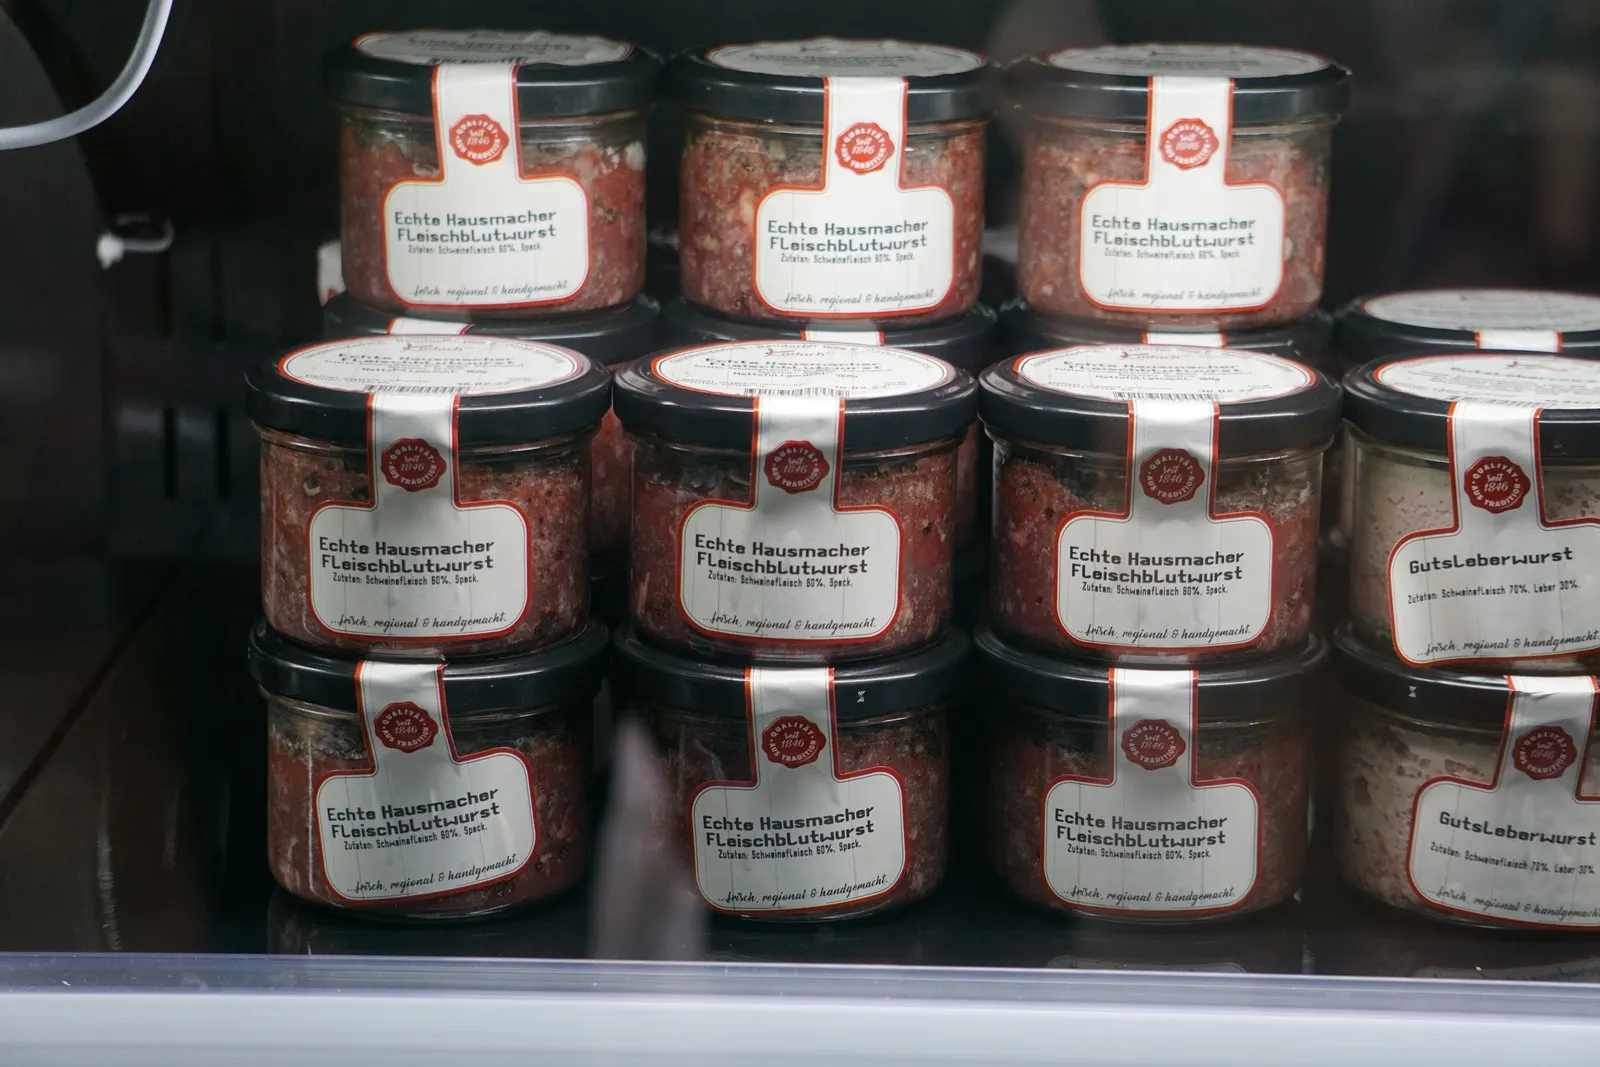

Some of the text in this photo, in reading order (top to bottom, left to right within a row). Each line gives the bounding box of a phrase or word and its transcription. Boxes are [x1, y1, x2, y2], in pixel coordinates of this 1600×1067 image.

[467, 136, 490, 145] 1846
[852, 144, 875, 154] 1846
[395, 211, 557, 226] Echte Hausmacher
[1092, 215, 1256, 231] Echte Hausmacher
[398, 225, 556, 243] Fleischblutwurst
[768, 220, 928, 235] Echte Hausmacher
[770, 235, 927, 252] Fleischblutwurst
[1094, 231, 1255, 248] Fleischblutwurst
[401, 462, 424, 471] 1846
[783, 463, 808, 473] 1846
[1158, 474, 1183, 483] 1846
[1484, 481, 1509, 493] 1846
[319, 536, 495, 556] Echte Hausmacher
[695, 534, 870, 557] Echte Hausmacher
[322, 554, 494, 573] Fleischblutwurst
[698, 552, 868, 575] Fleischblutwurst
[1069, 546, 1244, 566] Echte Hausmacher
[1410, 547, 1573, 574] Gutsleberwurst
[366, 575, 427, 586] Schweinefleisch
[1072, 563, 1242, 583] Fleischblutwurst
[740, 576, 802, 587] Schweinefleisch
[1117, 585, 1179, 596] Schweinefleisch
[1442, 586, 1505, 599] Schweinefleisch
[1534, 583, 1556, 592] Leber
[374, 618, 418, 632] regional
[423, 618, 430, 628] &
[746, 619, 791, 633] regional
[794, 620, 802, 629] &
[1122, 629, 1167, 643] regional
[1172, 629, 1178, 638] &
[1463, 639, 1509, 654] regional
[1514, 639, 1521, 647] &
[394, 725, 418, 734] 1846
[781, 738, 805, 747] 1846
[1140, 740, 1165, 750] 1846
[327, 789, 498, 821] Echte Hausmacher
[332, 803, 500, 838] Fleischblutwurst
[703, 806, 874, 831] Echte Hausmacher
[1055, 808, 1227, 831] Echte Hausmacher
[706, 820, 874, 848] Fleischblutwurst
[1439, 811, 1596, 846] Gutsleberwurst
[377, 834, 437, 849] Schweinefleisch
[1057, 826, 1226, 848] Fleischblutwurst
[752, 850, 813, 859] Schweinefleisch
[1101, 848, 1162, 860] Schweinefleisch
[391, 874, 434, 893] regional
[438, 872, 445, 881] &
[762, 889, 807, 906] regional
[811, 889, 817, 897] &
[1107, 890, 1152, 904] regional
[1155, 892, 1162, 901] &
